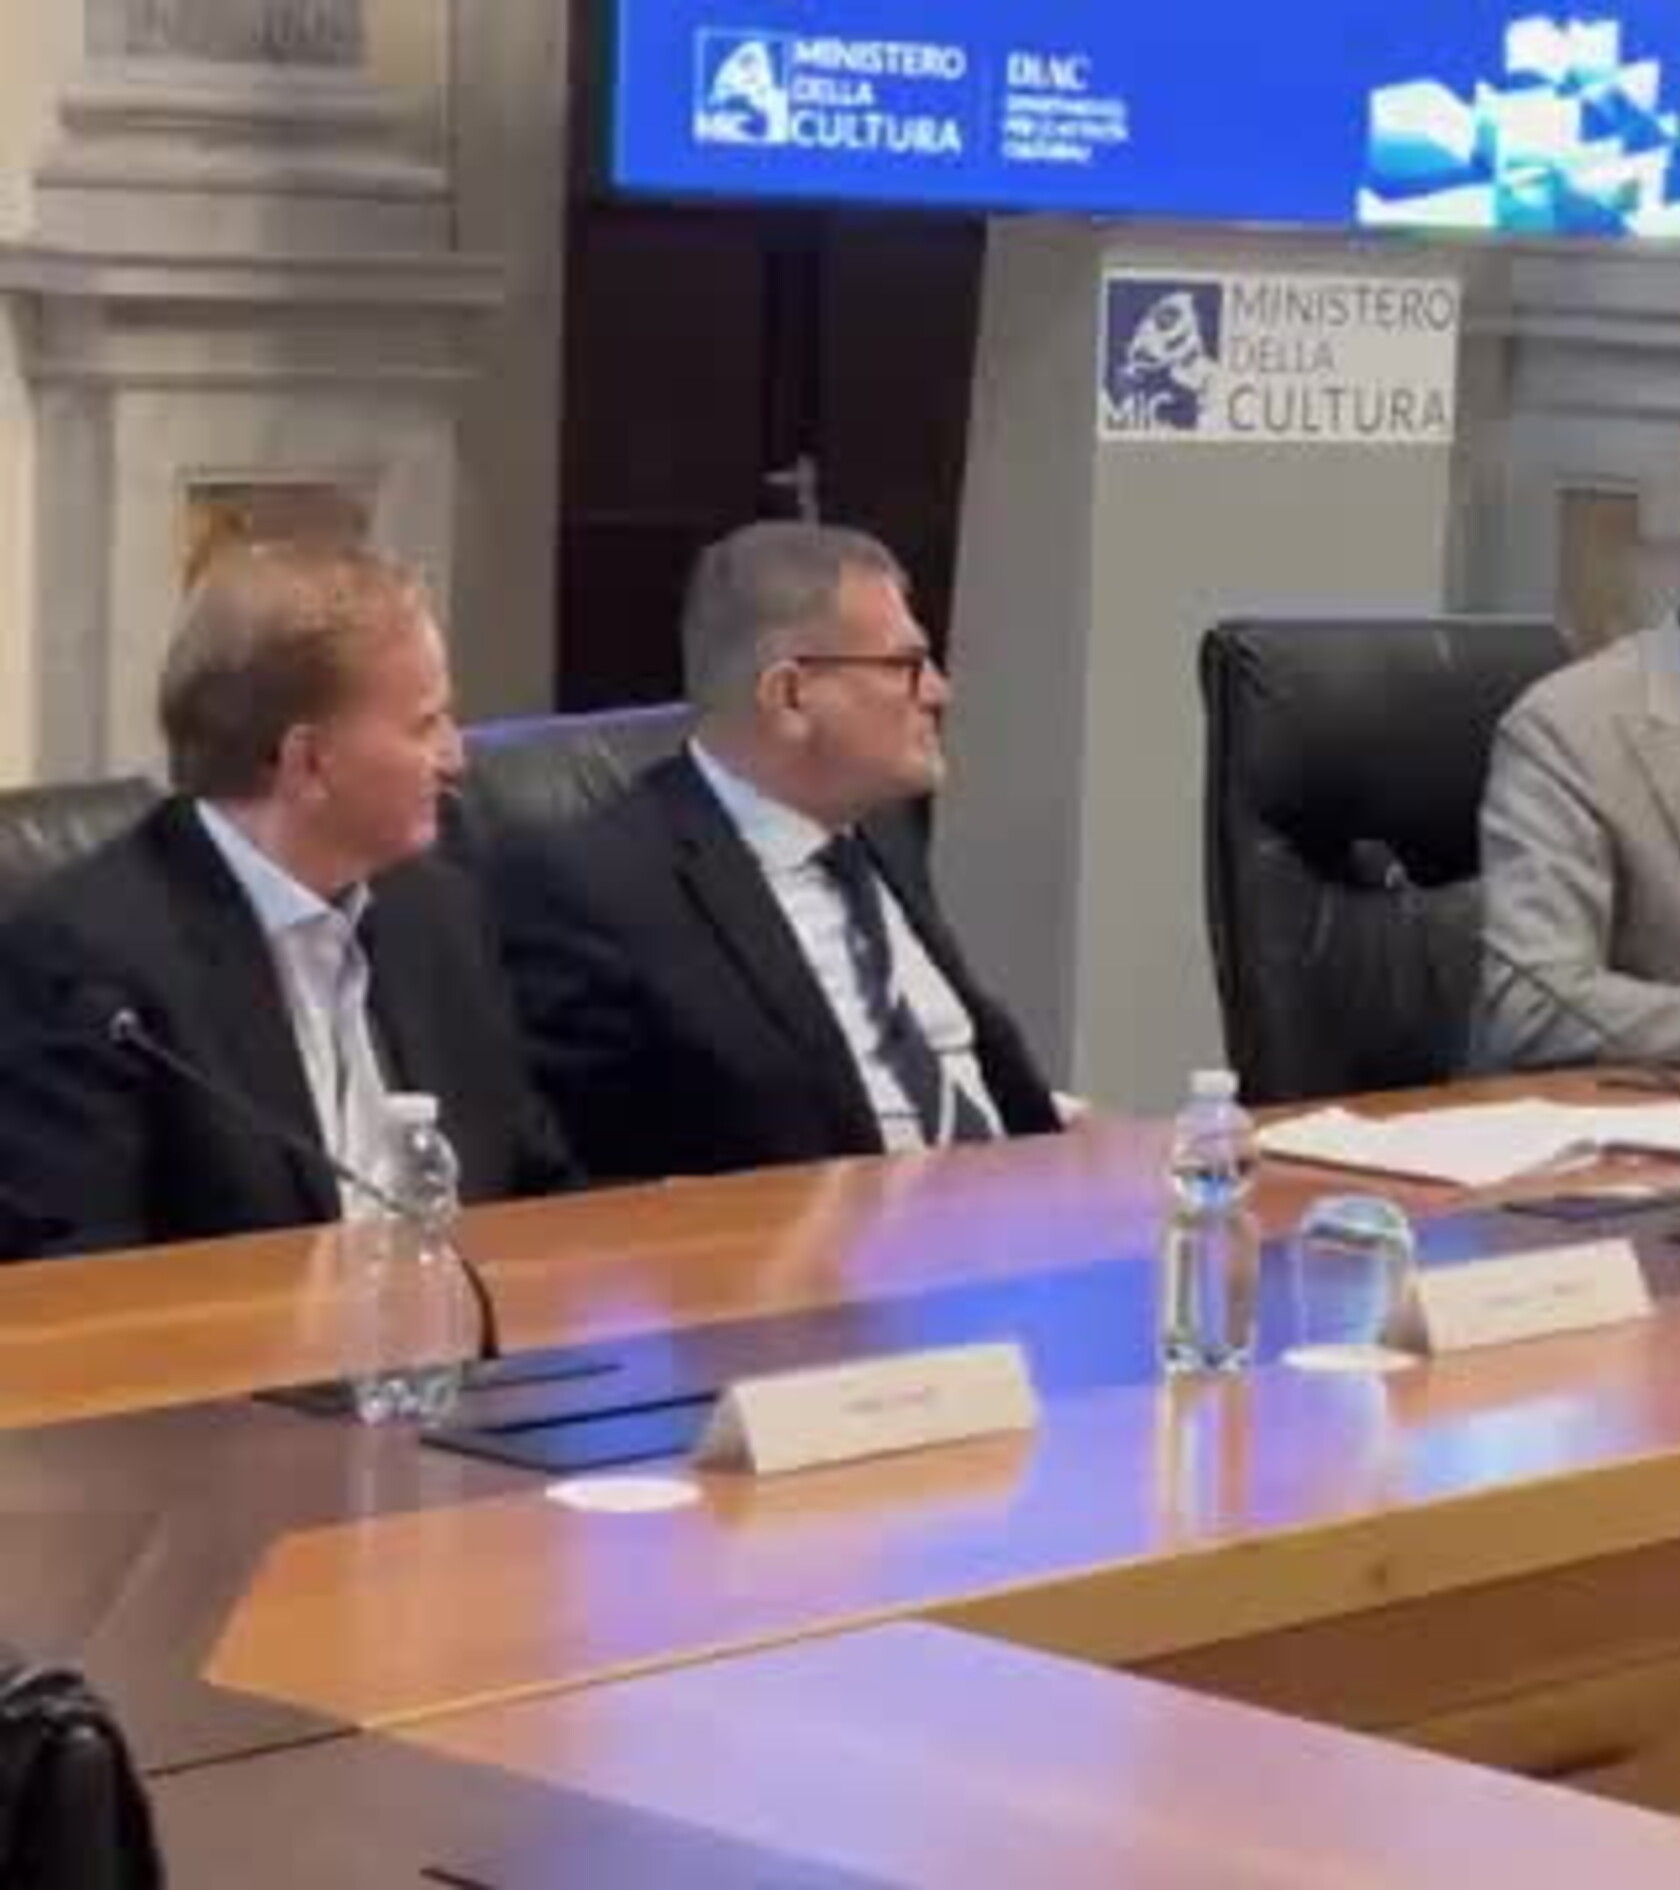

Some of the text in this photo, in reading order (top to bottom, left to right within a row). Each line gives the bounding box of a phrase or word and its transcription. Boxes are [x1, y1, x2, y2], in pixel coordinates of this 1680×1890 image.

[793, 37, 966, 80] MINISTERO
[793, 75, 875, 107] DELLA
[792, 110, 963, 155] CULTURA
[1231, 283, 1456, 332] MINISTERO
[1230, 336, 1335, 375] DELLA
[1228, 384, 1448, 433] CULTURA
